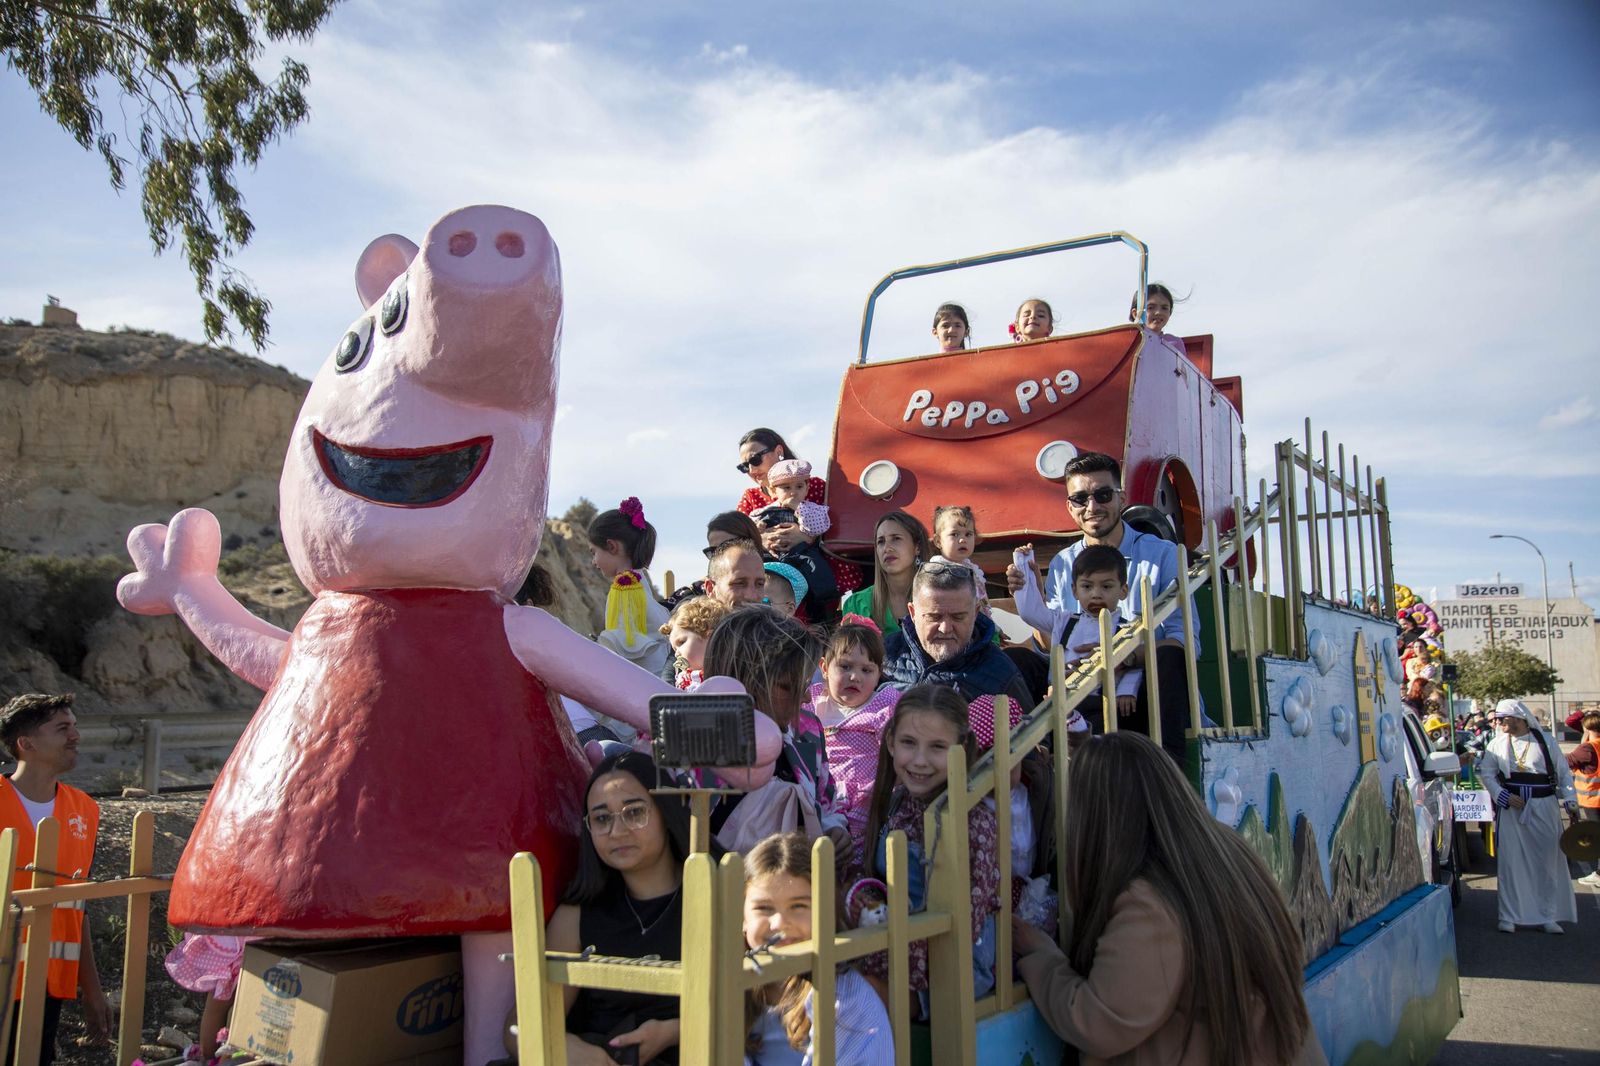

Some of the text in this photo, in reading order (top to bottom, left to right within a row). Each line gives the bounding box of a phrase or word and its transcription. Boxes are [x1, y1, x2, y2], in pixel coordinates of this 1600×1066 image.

[903, 369, 1080, 429] Peppa Pig
[1461, 585, 1519, 596] Jazena
[1441, 618, 1502, 629] RANITOS
[267, 970, 299, 995] Fini
